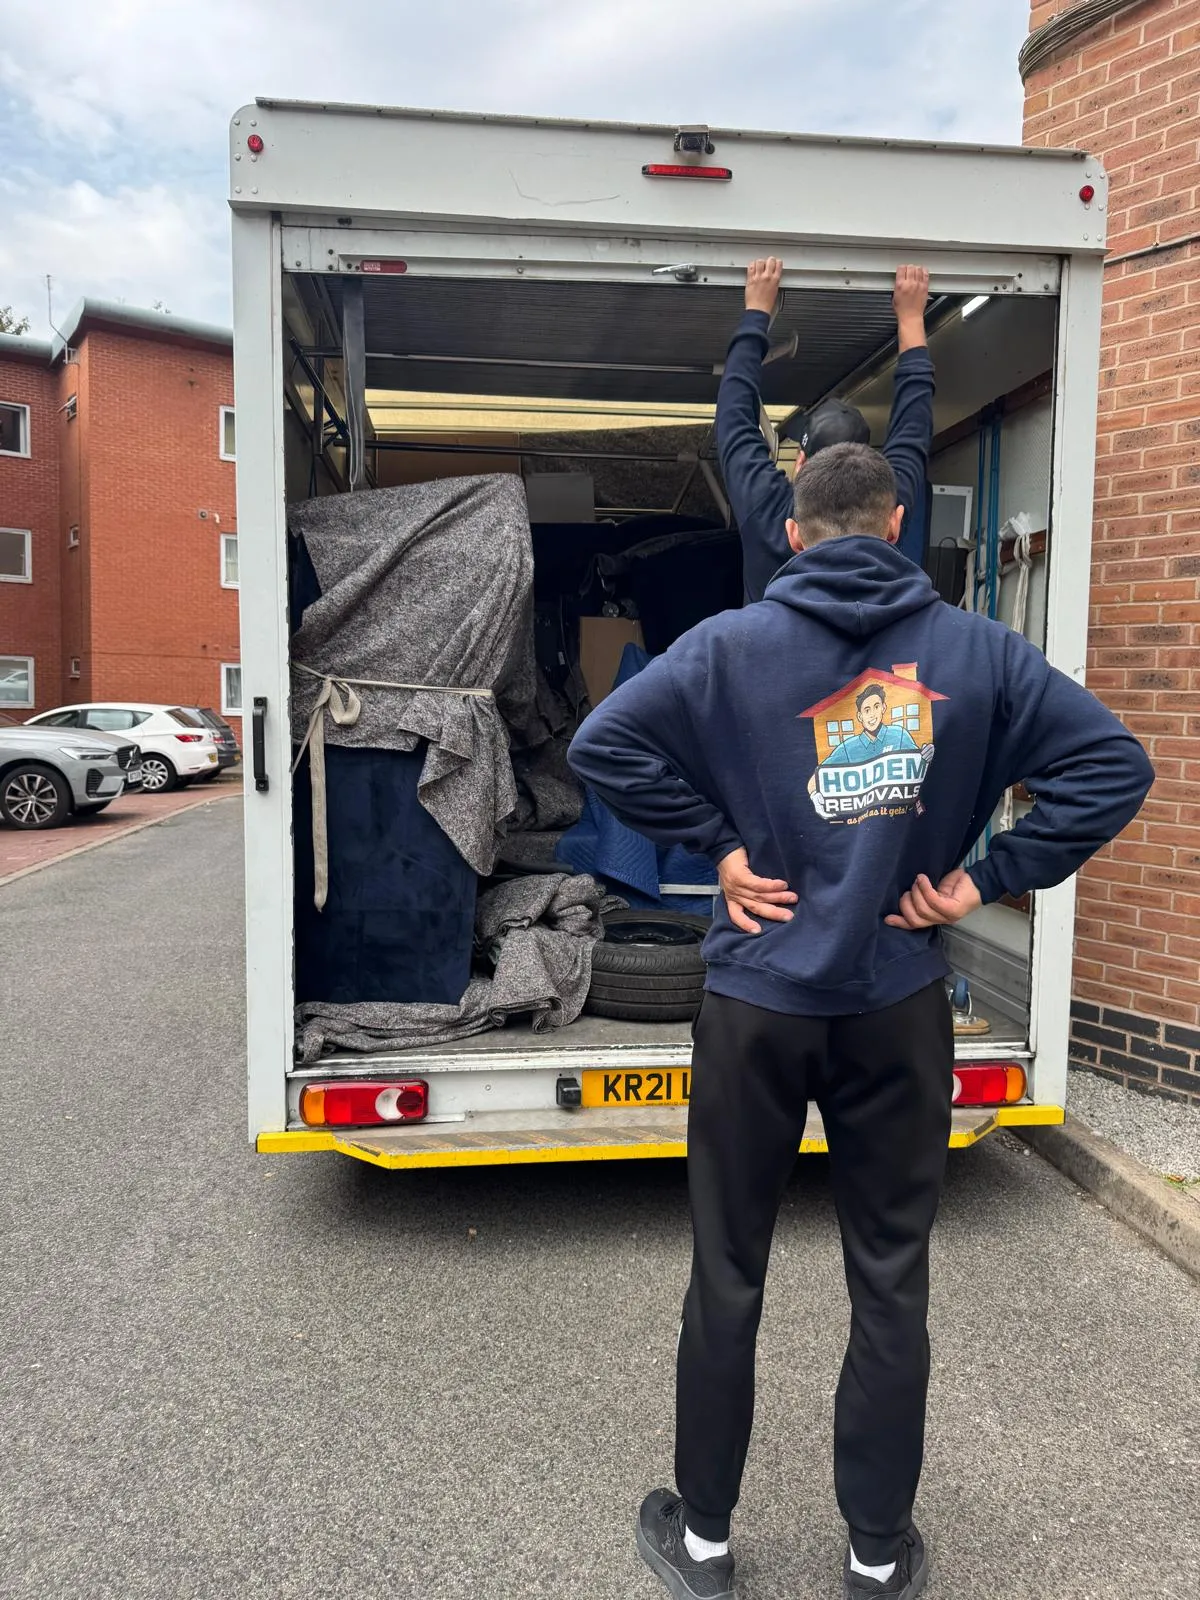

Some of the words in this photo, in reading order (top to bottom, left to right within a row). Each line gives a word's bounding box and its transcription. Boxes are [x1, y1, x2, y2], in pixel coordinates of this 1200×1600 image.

[822, 757, 927, 793] HOLDEM
[825, 785, 920, 813] REMOVALS
[880, 806, 888, 815] it
[603, 1072, 672, 1102] KR21
[682, 1072, 691, 1100] L
